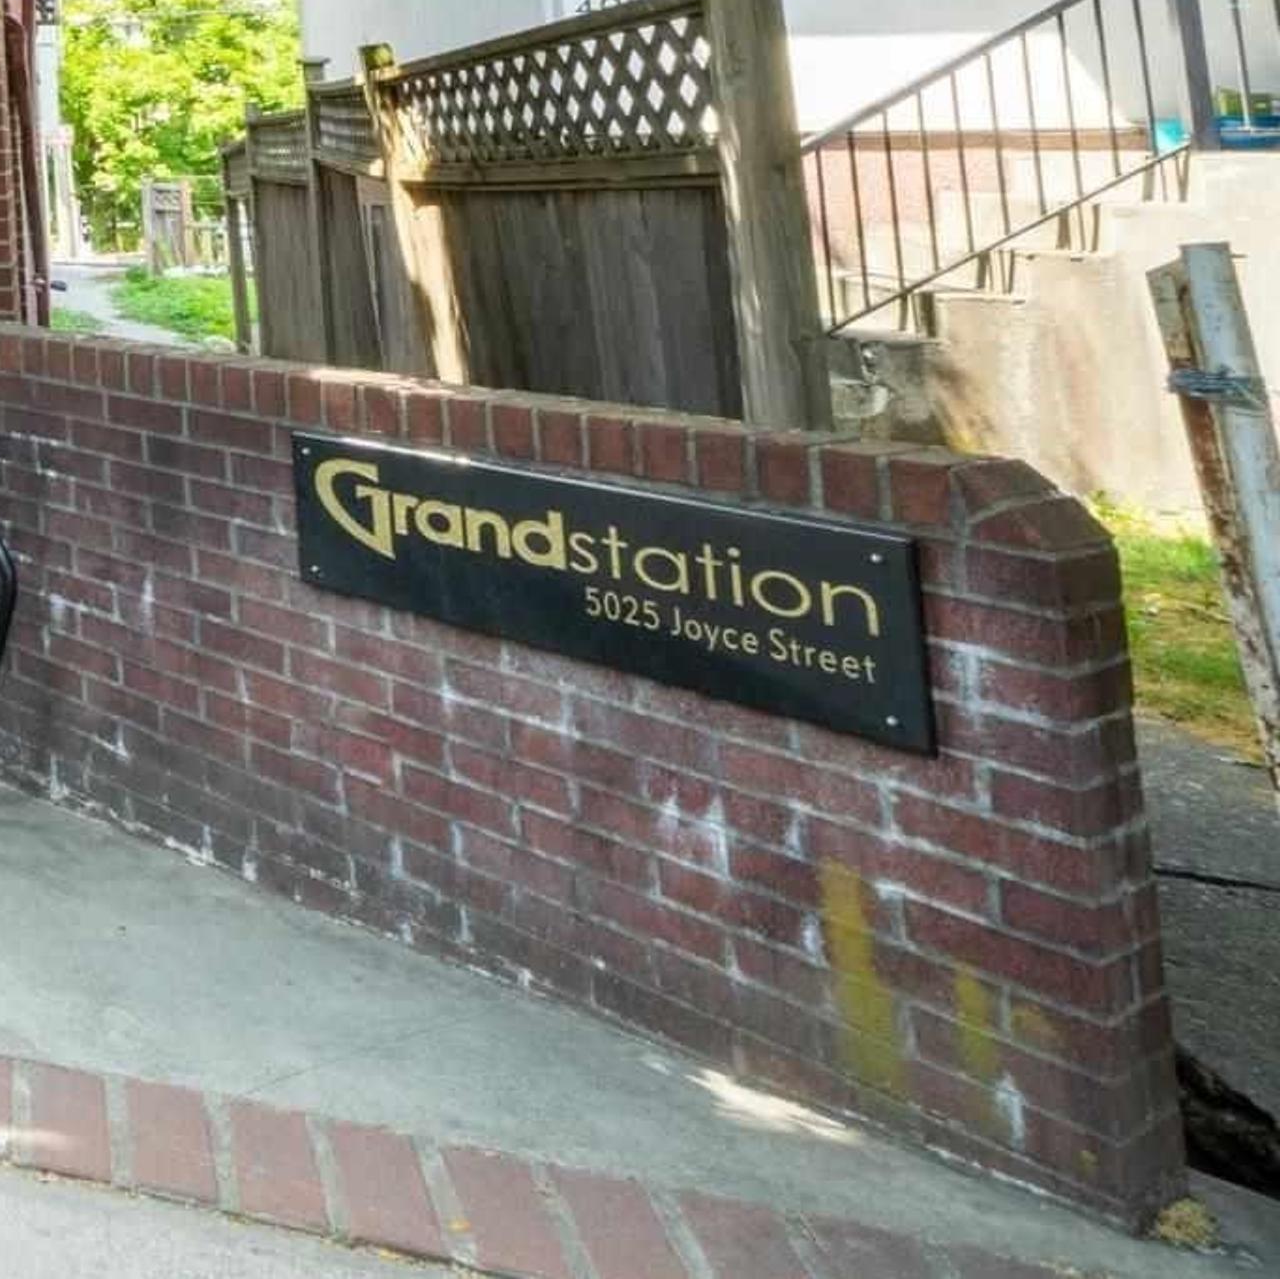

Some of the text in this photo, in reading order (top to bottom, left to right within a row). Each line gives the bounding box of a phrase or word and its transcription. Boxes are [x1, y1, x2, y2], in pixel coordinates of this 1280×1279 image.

[313, 458, 881, 637] Grandstation
[584, 586, 877, 683] 5025 Joyce Street
